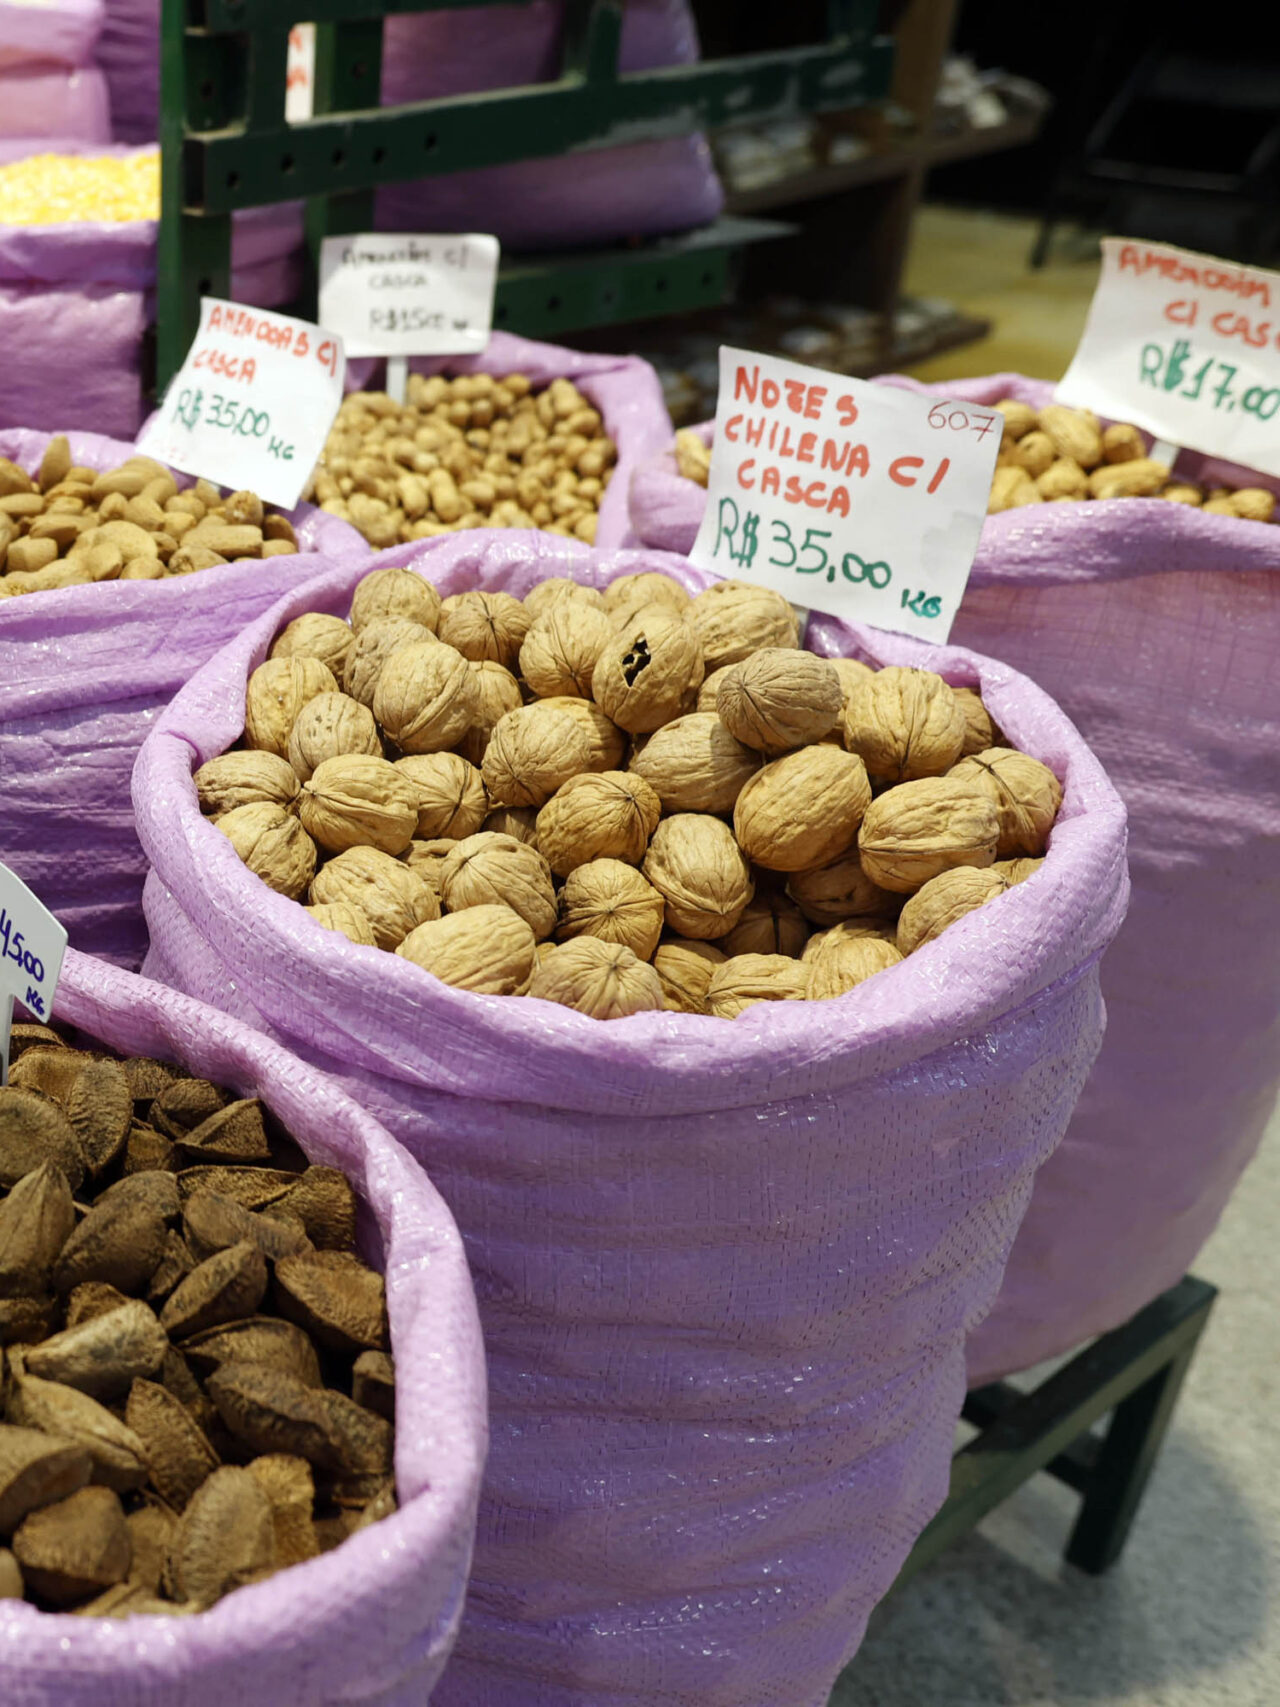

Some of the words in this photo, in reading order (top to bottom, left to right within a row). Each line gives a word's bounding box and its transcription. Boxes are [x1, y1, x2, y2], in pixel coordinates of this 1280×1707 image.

[1212, 312, 1280, 352] CAS
[734, 365, 858, 426] NOZES
[928, 400, 995, 442] 607
[724, 414, 870, 477] CHILENA
[737, 458, 850, 518] CASCA
